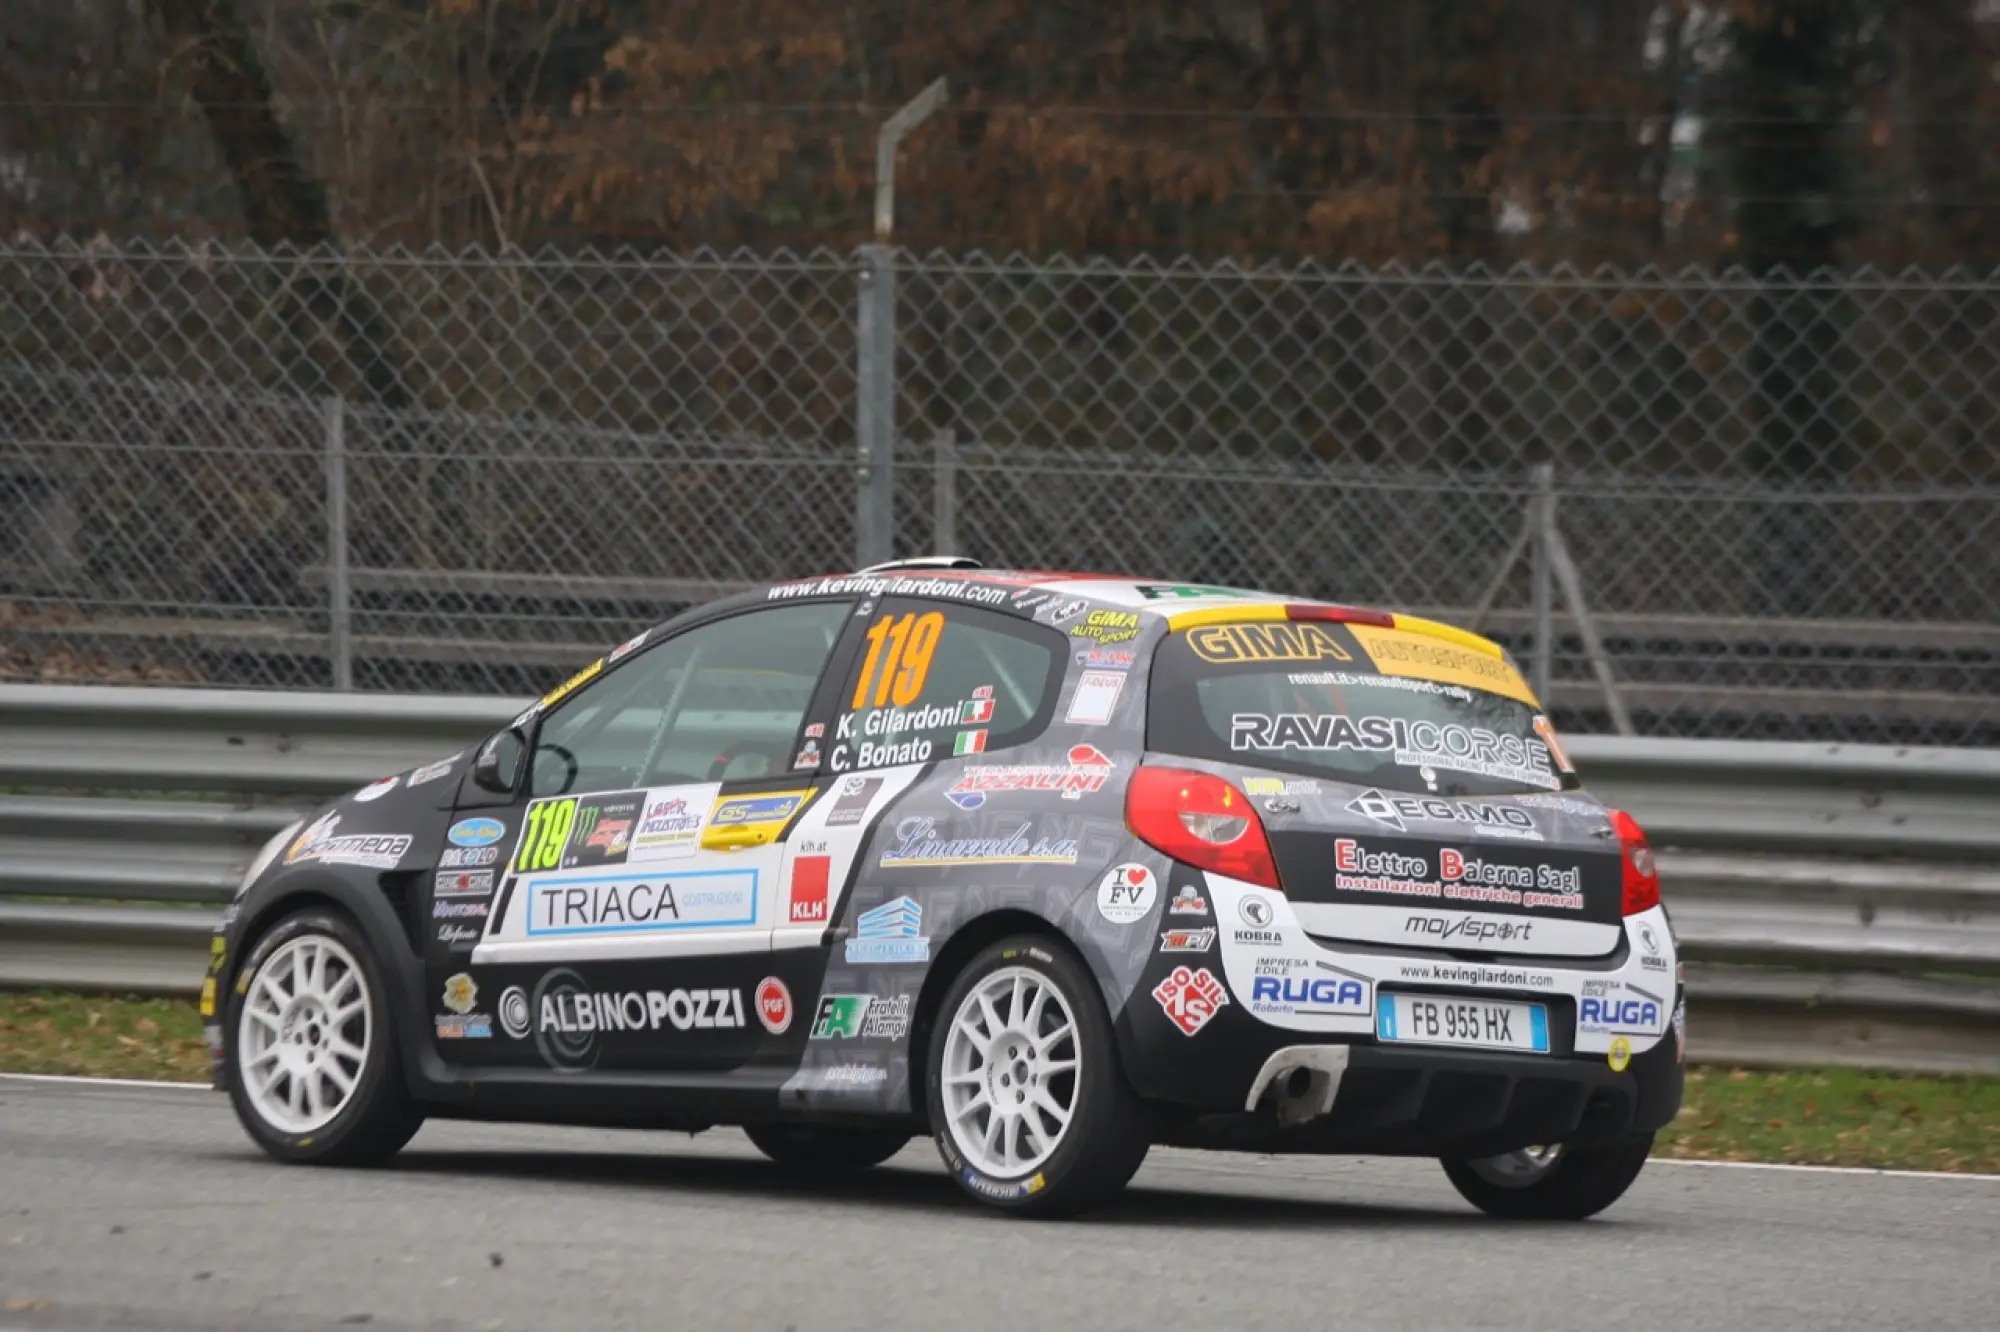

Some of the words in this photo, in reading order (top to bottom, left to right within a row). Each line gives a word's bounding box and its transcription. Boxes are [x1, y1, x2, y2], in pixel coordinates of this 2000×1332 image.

[768, 577, 1006, 604] www.kevingilardoni.com
[1070, 625, 1102, 640] AUTO
[1087, 610, 1139, 630] GIMA
[1186, 622, 1353, 663] GIMA
[852, 612, 944, 709] 119
[1368, 638, 1512, 685] AUTOSPORT
[836, 713, 857, 740] K.
[864, 699, 965, 736] Gilardoni
[830, 744, 851, 772] C.
[857, 736, 932, 769] Bonato
[953, 774, 1107, 792] AZZALINI
[519, 799, 576, 871] 119
[1113, 867, 1126, 886] I
[1335, 839, 1427, 876] Elettro
[1537, 865, 1580, 892] Sagl
[541, 884, 679, 925] TRIACA
[682, 890, 743, 908] COSTRUZIONI
[1109, 886, 1144, 904] FV
[1336, 875, 1441, 897] Installazioni
[1444, 887, 1521, 904] elettriche
[1524, 894, 1584, 909] generali
[792, 901, 822, 918] KLH
[1234, 930, 1282, 942] KOBRA
[1405, 916, 1533, 942] movisport
[1255, 966, 1289, 975] EDILE
[1257, 957, 1309, 967] IMPRESA
[1400, 965, 1553, 987] www.kevingilardoni.com
[1252, 976, 1362, 1005] RUGA
[868, 996, 909, 1015] Fratelli
[1252, 1003, 1293, 1013] Roberto
[1580, 998, 1657, 1026] RUGA
[1412, 1002, 1439, 1036] FB
[1445, 1004, 1478, 1039] 955
[1484, 1007, 1512, 1041] HX
